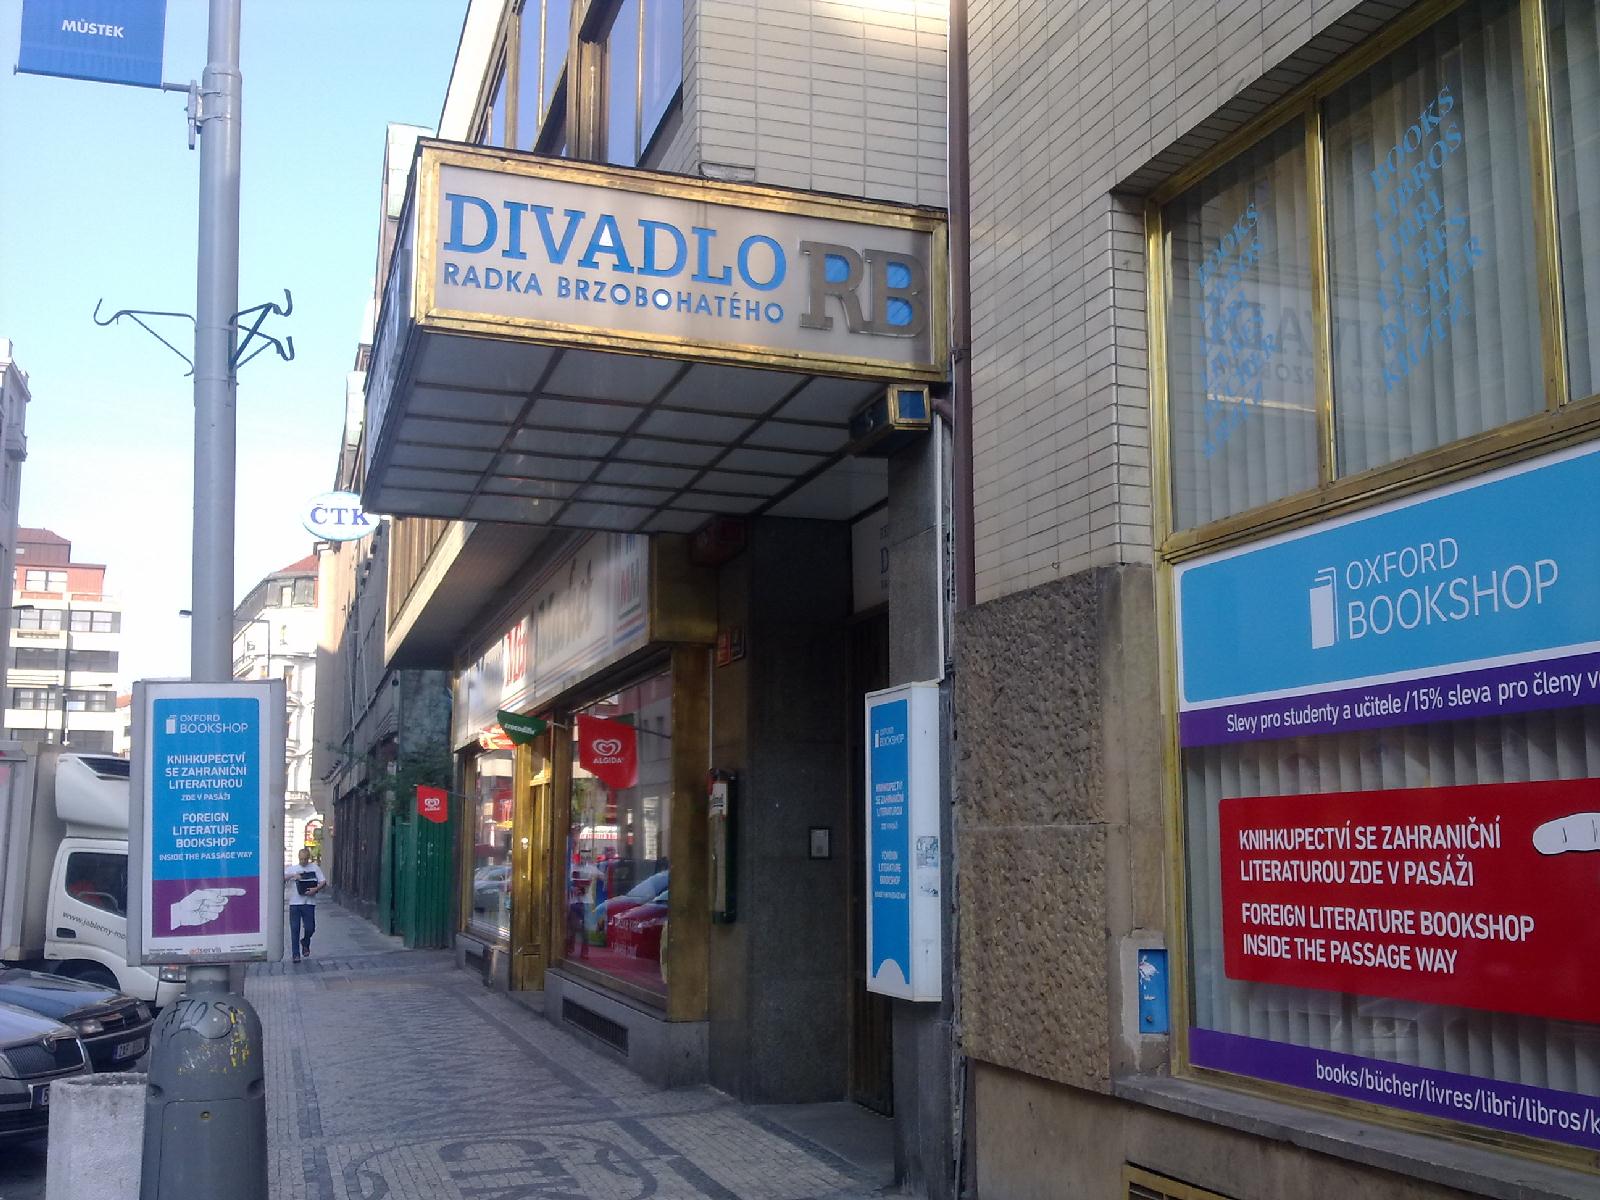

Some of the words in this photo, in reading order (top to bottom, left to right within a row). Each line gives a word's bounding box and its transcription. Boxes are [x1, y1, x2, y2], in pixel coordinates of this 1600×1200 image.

[443, 192, 787, 292] DIVADLO
[443, 262, 543, 297] RADKA
[556, 275, 785, 324] BRZOBOHATÉHO
[800, 240, 928, 338] RB
[1345, 536, 1459, 590] OXFORD
[1348, 558, 1559, 640] BOOKSHOP
[179, 714, 221, 722] OXFORD
[1226, 713, 1258, 733] Slevy
[1260, 712, 1282, 731] pro
[1283, 703, 1340, 727] studenty
[1343, 705, 1351, 720] a
[1448, 683, 1492, 707] sleva
[1498, 680, 1528, 706] pro
[1532, 670, 1583, 697] členy
[180, 722, 249, 734] BOOKSHOP
[165, 767, 180, 777] SE
[181, 763, 247, 777] ZAHRANIČNÍ
[167, 751, 246, 765] KNIHKUPECTVÍ
[592, 756, 622, 764] ALGIDA
[169, 779, 243, 790] LITERATUROU
[172, 824, 239, 836] LITERATURE
[182, 812, 229, 823] FOREIGN
[1238, 820, 1351, 852] KNIHKUPECTVÍ
[1354, 825, 1377, 850] SE
[1381, 815, 1501, 850] ZAHRANIČNÍ
[175, 837, 236, 848] BOOKSHOP
[1240, 859, 1346, 884] LITERATUROU
[1349, 860, 1384, 885] ZDE
[1388, 860, 1400, 886] V
[1404, 853, 1474, 887] PASÁŽI
[1241, 902, 1307, 928] FOREIGN
[1309, 905, 1416, 935] LITERATURE
[1420, 911, 1535, 943] BOOKSHOP
[1243, 933, 1291, 960] INSIDE
[1294, 937, 1326, 963] THE
[1330, 940, 1412, 971] PASSAGE
[1415, 947, 1458, 975] WAY
